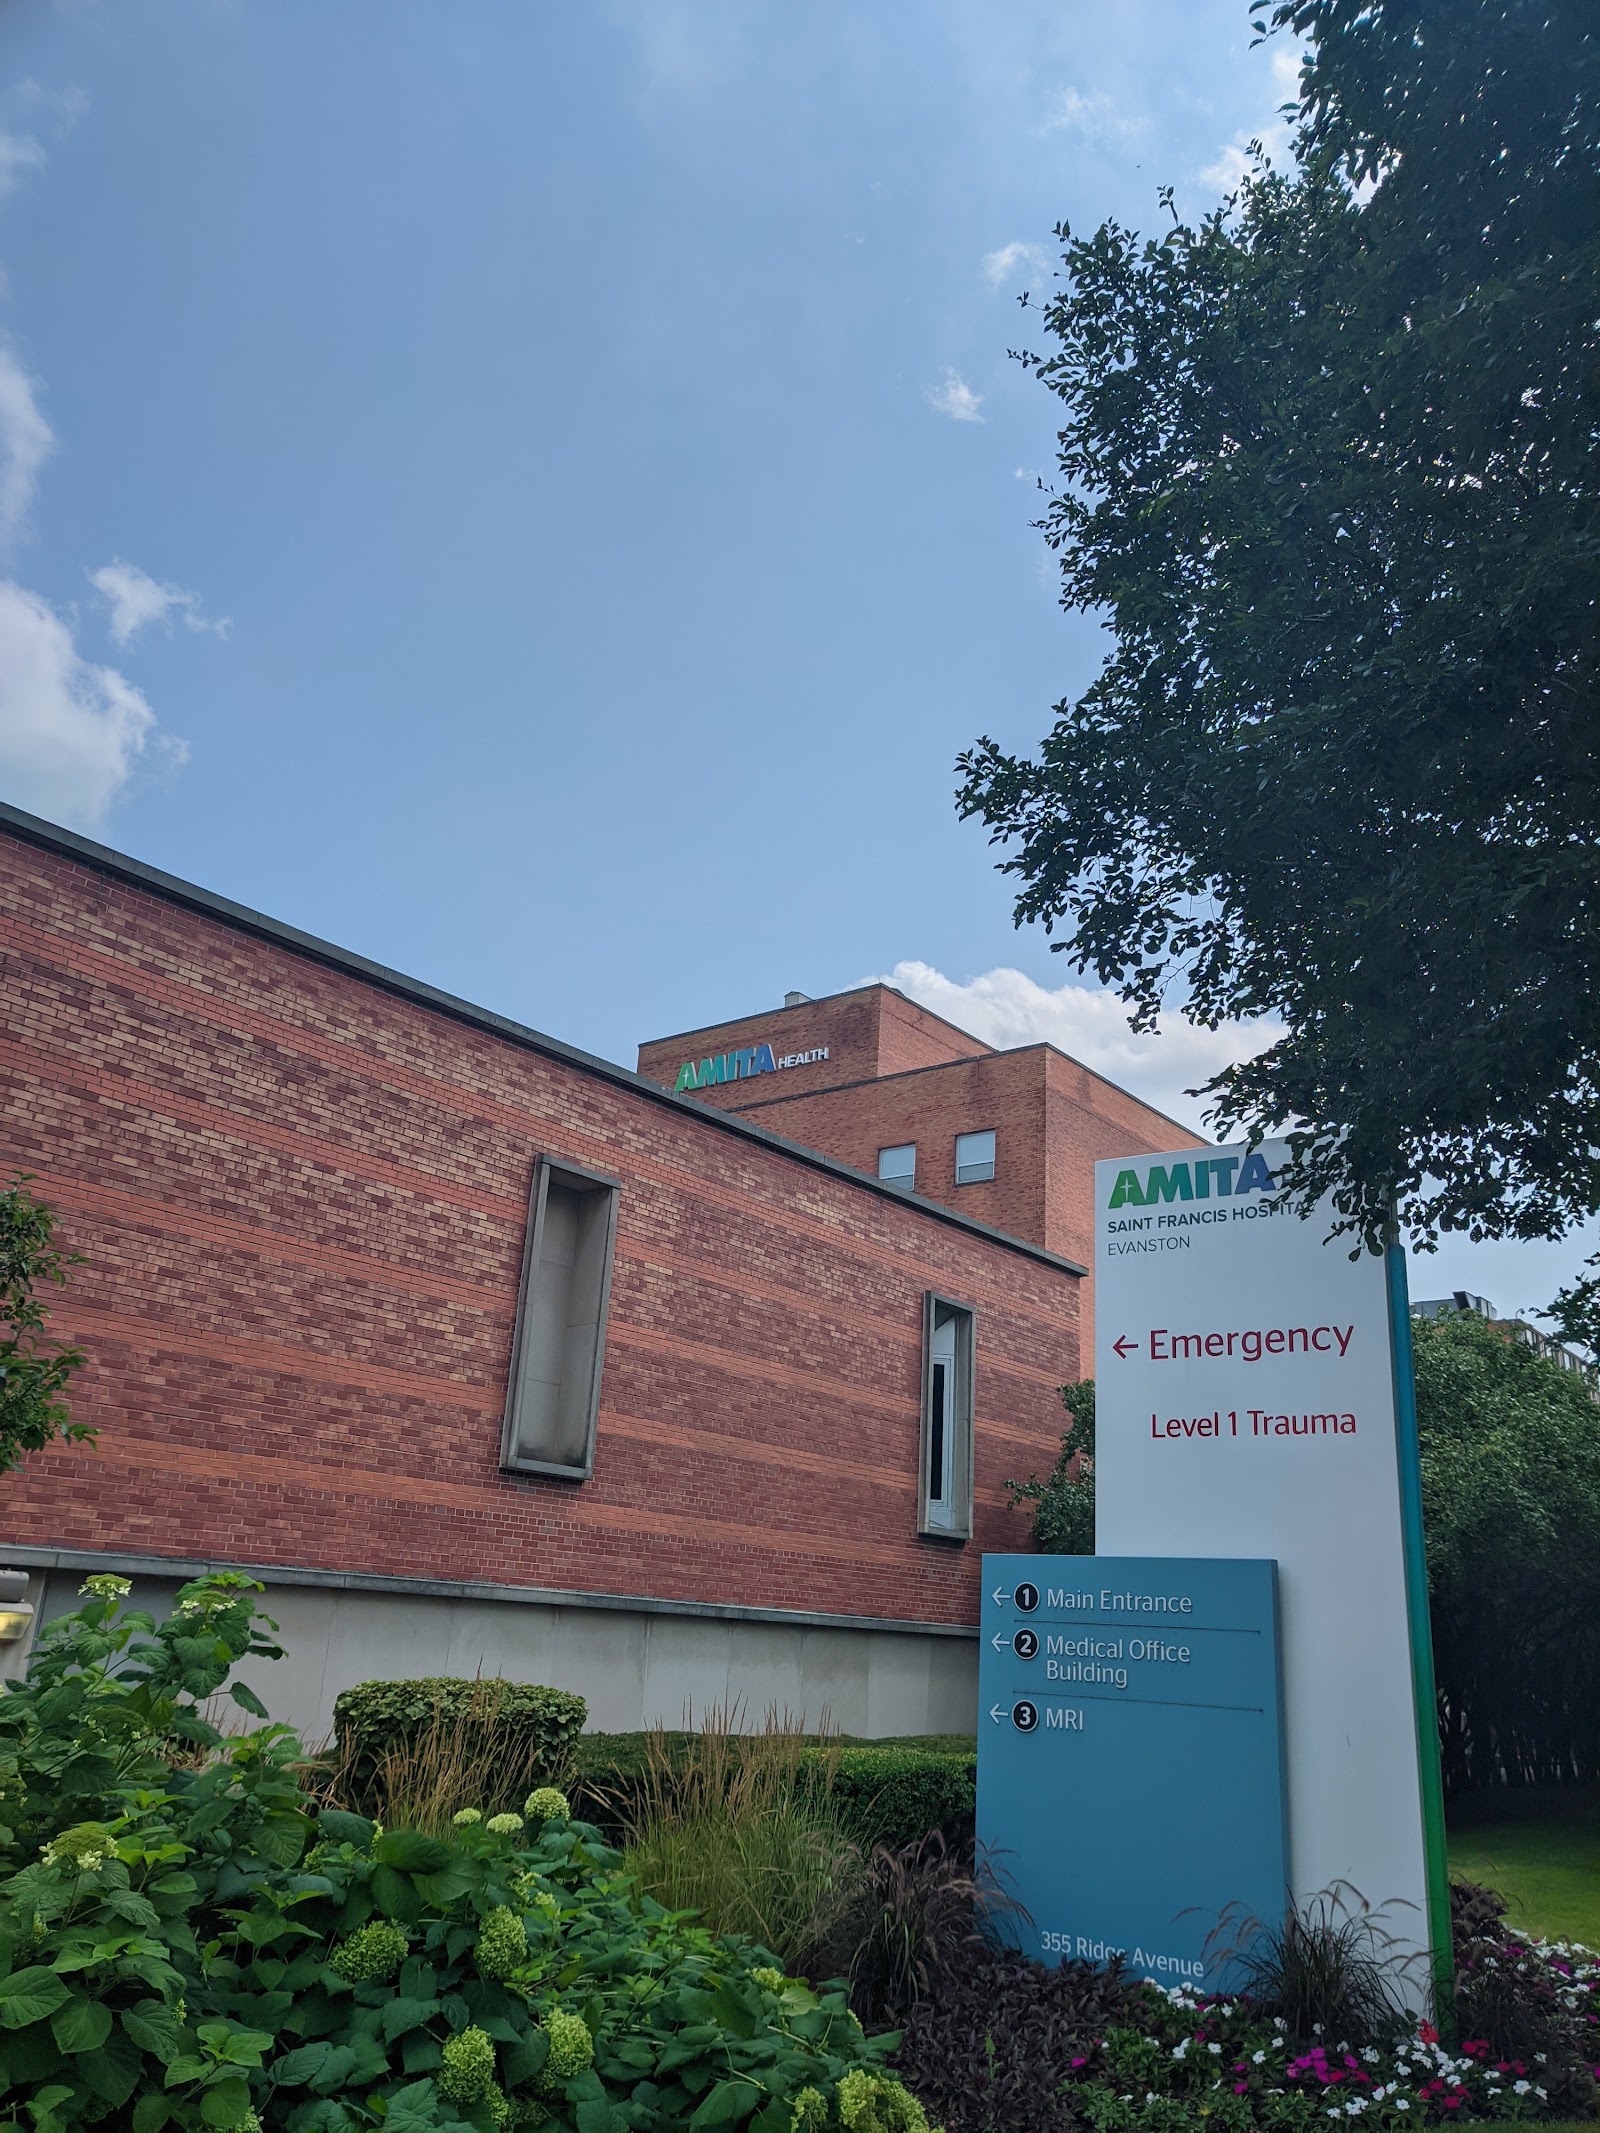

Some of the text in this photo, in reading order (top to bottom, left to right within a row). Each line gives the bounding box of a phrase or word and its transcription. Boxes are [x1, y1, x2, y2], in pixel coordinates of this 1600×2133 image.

[673, 1043, 829, 1092] AMITA HEALTH
[1108, 1153, 1277, 1209] AMITA
[1107, 1200, 1306, 1233] SAINT FRANCIS HOSITA
[1108, 1235, 1191, 1256] EVANSTON
[1150, 1325, 1354, 1361] Emergency
[1152, 1410, 1356, 1438] Level 1 Trauma
[1047, 1588, 1094, 1610] Main
[1100, 1590, 1193, 1613] Entrance
[1020, 1634, 1192, 1663] 2 Medical Office
[1046, 1660, 1128, 1689] Building
[1019, 1706, 1084, 1731] 3 MRI
[1041, 1931, 1072, 1953] 355
[1132, 1947, 1204, 1977] Avenue
